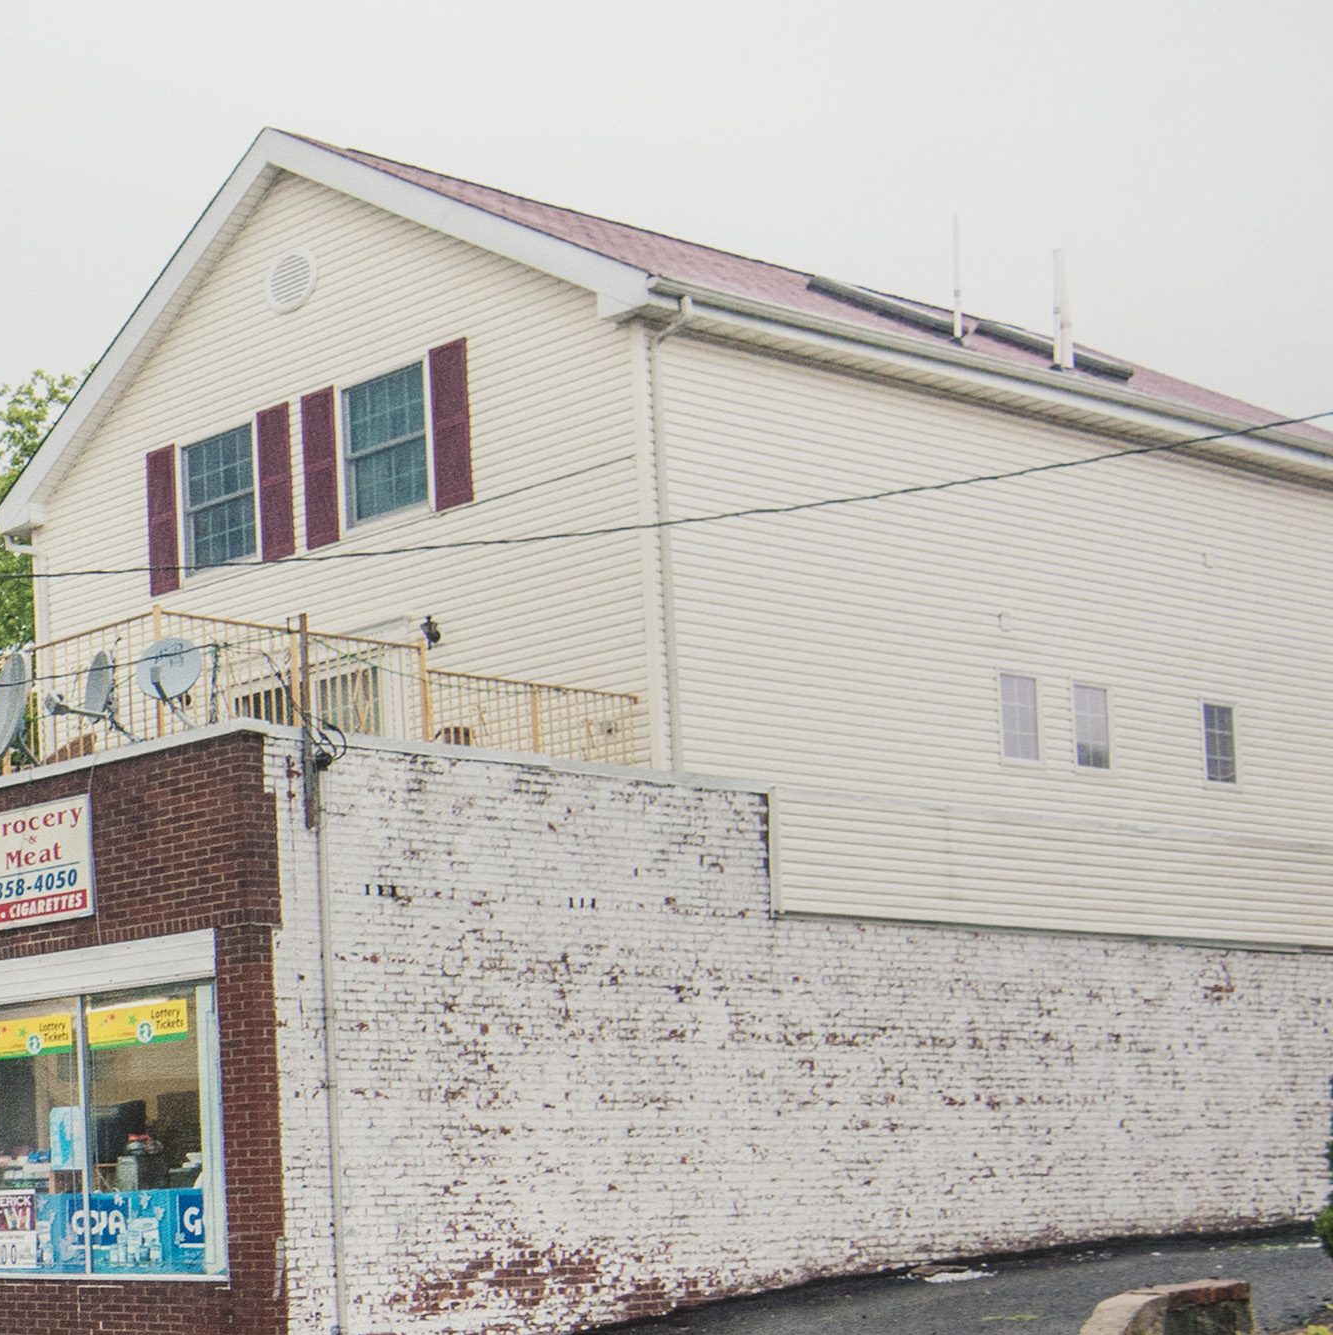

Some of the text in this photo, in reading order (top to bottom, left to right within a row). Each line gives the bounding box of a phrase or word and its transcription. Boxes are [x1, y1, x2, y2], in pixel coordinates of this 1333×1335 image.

[27, 834, 39, 846] &
[5, 842, 63, 870] Meat
[9, 892, 83, 918] CIGARETTES
[150, 1008, 182, 1020] Lottery
[39, 1022, 66, 1033] Lottery
[156, 1018, 185, 1030] Tickets
[44, 1031, 69, 1043] Tickets
